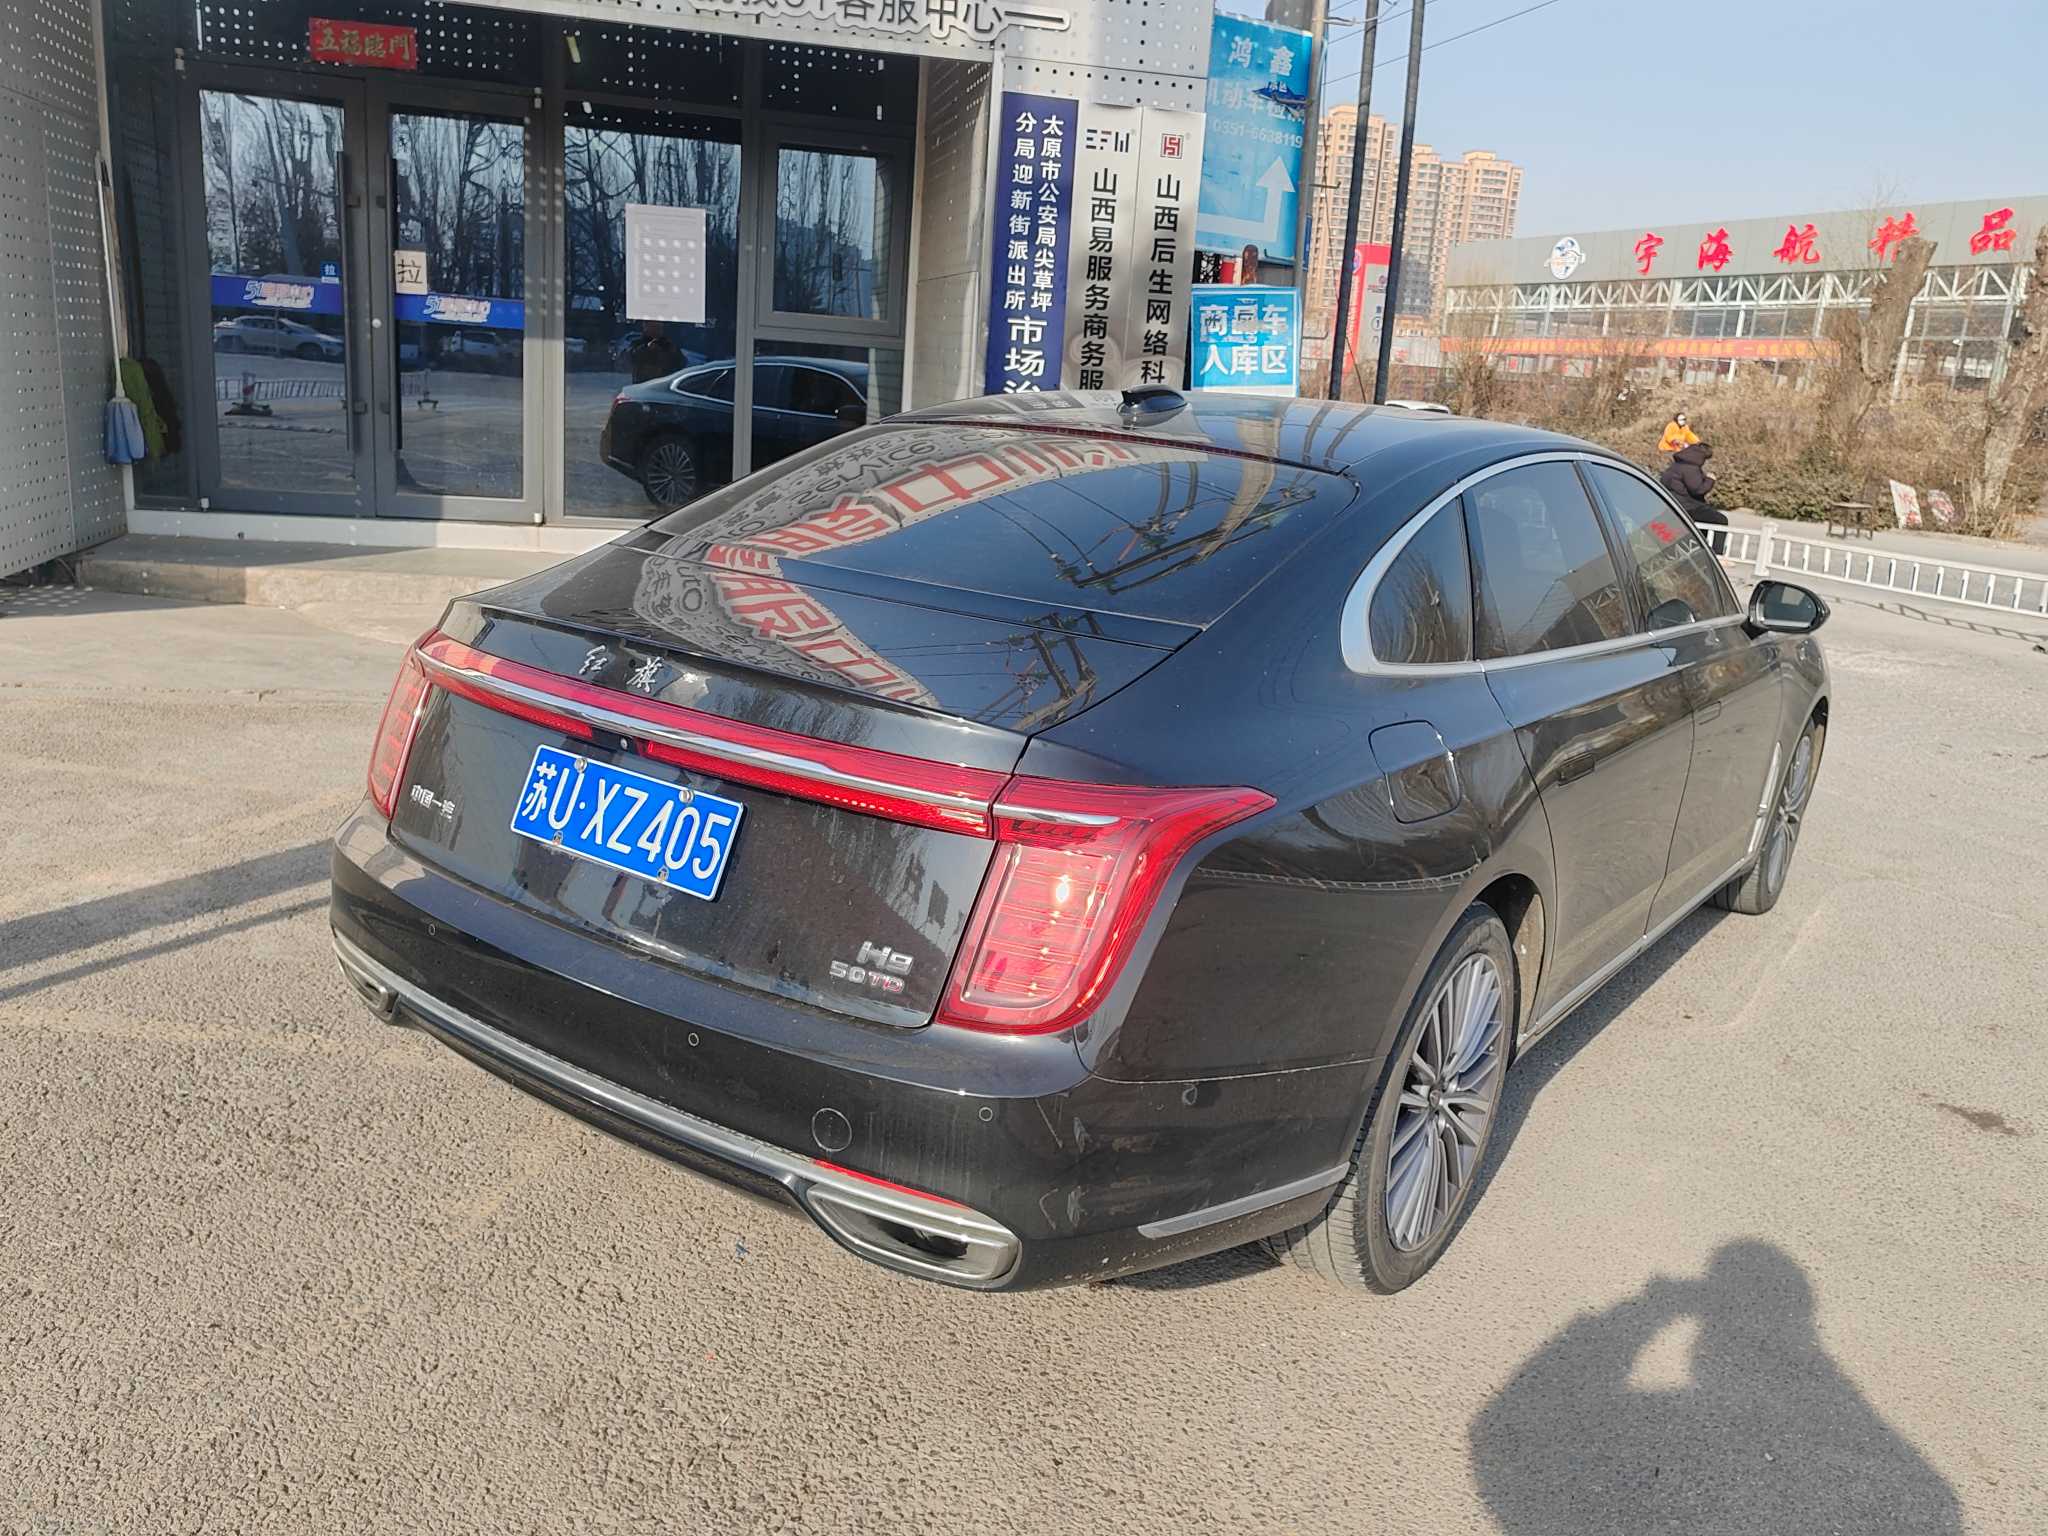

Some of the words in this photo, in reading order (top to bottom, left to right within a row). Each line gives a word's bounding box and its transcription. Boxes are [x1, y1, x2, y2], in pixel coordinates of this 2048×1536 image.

[316, 27, 410, 61] 五福臨門
[1003, 111, 1037, 311] 分局迎新街派出所
[1030, 114, 1064, 313] 太原市公安局尖草坪
[397, 259, 423, 284] 拉
[1140, 173, 1181, 384] 山西后生网络科
[1200, 344, 1287, 375] 入库区
[579, 644, 664, 693] 红旗
[410, 784, 456, 822] 中国一汽
[522, 761, 732, 880] 苏U·XZ405
[856, 941, 914, 975] H9
